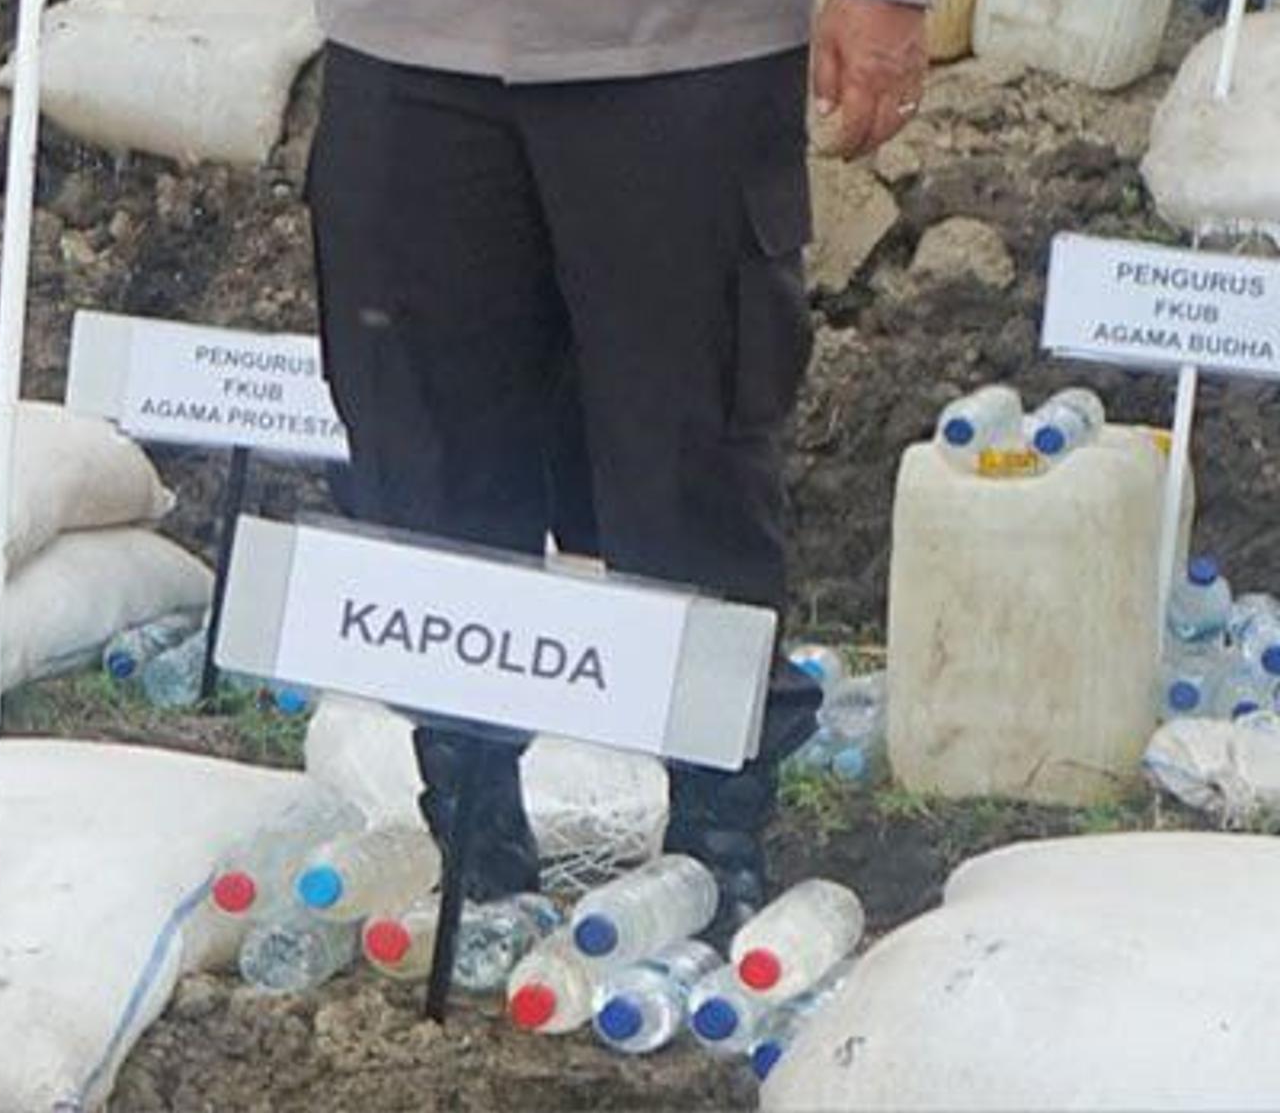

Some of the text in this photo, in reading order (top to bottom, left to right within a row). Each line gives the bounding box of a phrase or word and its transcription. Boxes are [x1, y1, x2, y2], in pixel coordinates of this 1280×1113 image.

[1115, 261, 1266, 299] PENGURUS
[1153, 297, 1220, 324] FKUB
[194, 344, 318, 377] PENGURUS
[1092, 322, 1275, 361] AGAMA BUDHA
[222, 377, 284, 403] FKUB
[139, 397, 346, 439] AGAMA PROTESTA
[337, 597, 611, 691] KAPOLDA
